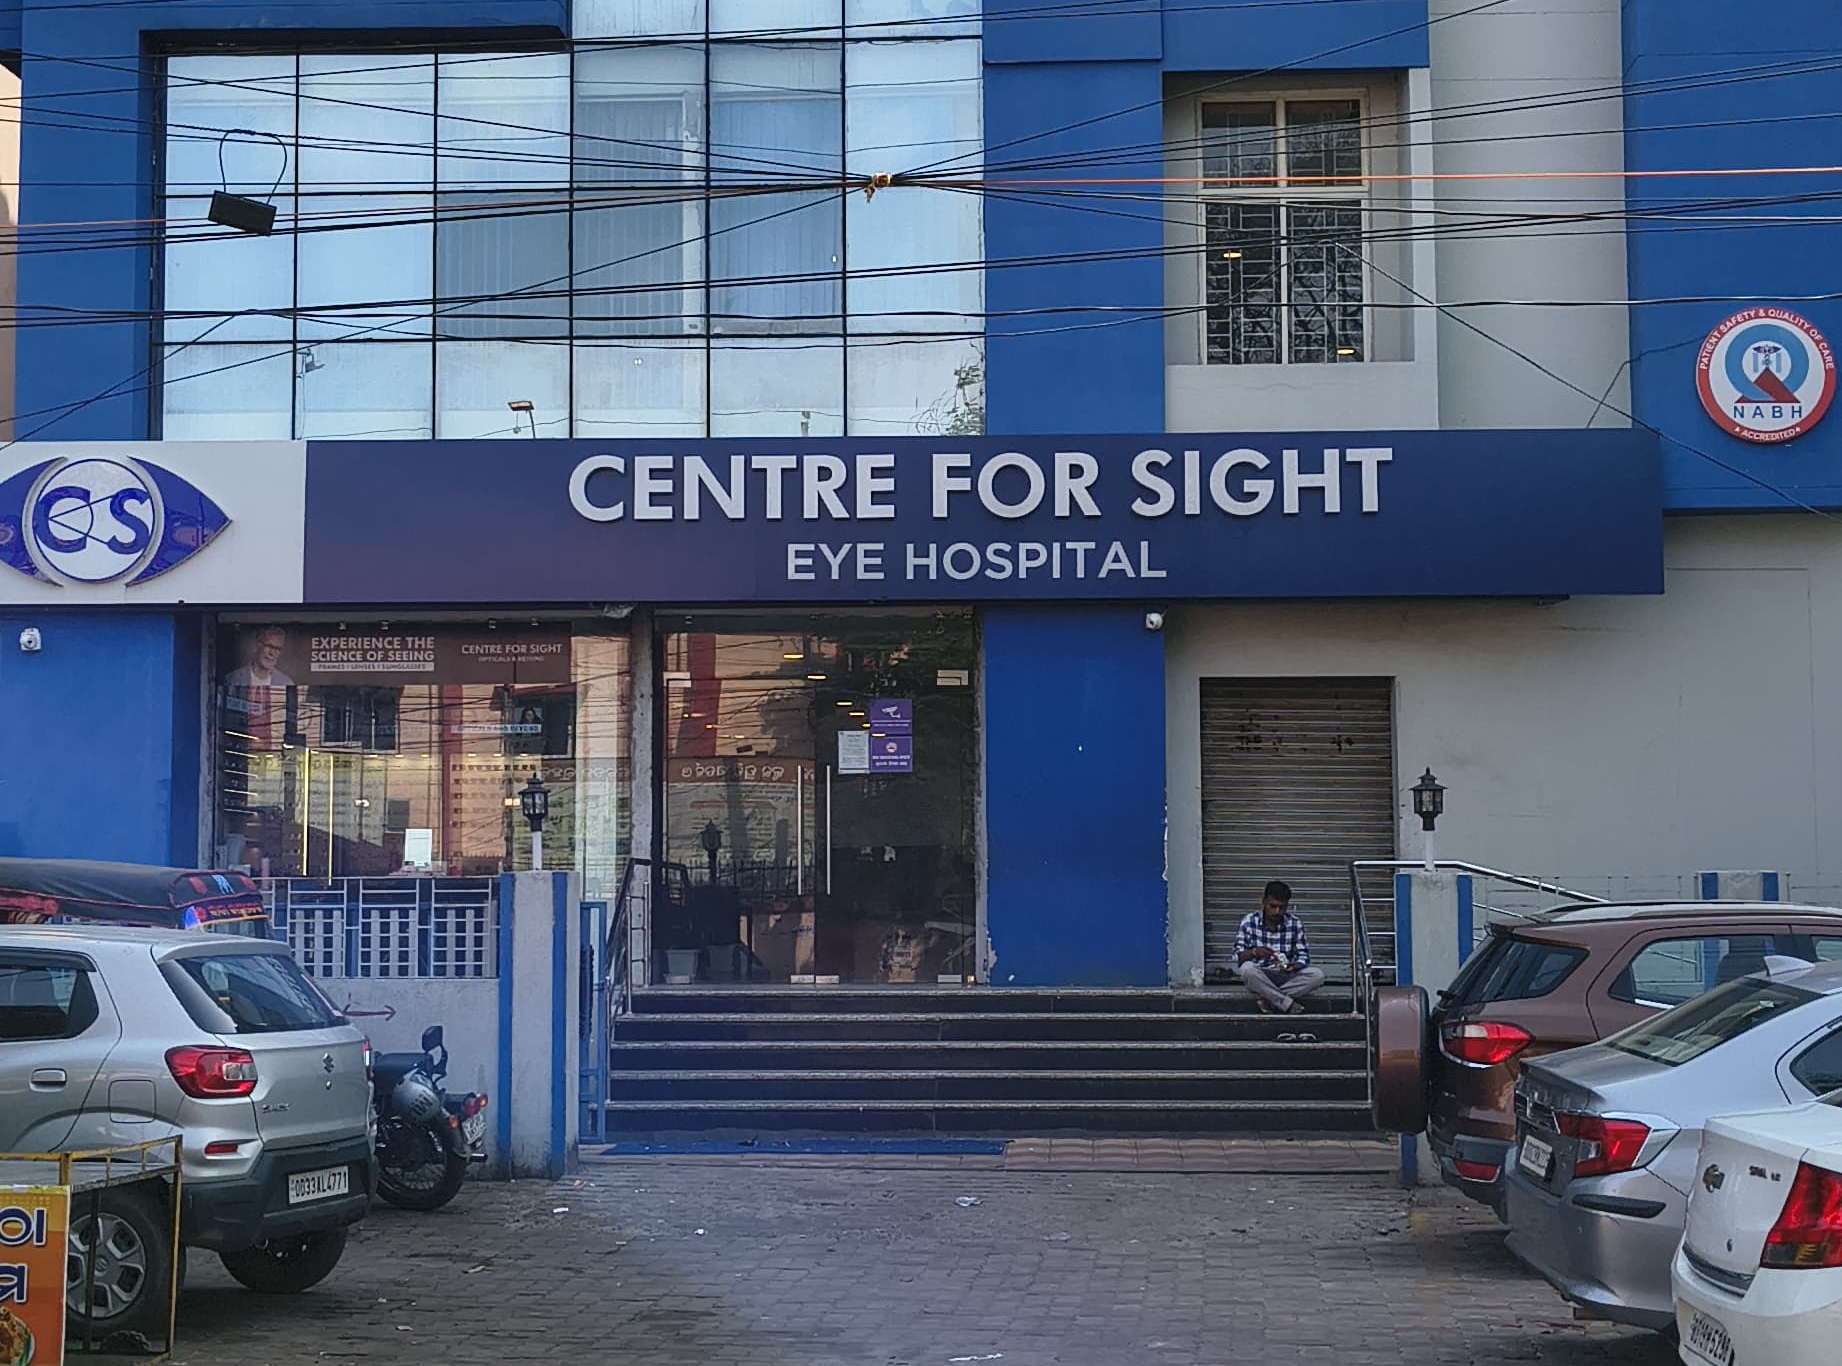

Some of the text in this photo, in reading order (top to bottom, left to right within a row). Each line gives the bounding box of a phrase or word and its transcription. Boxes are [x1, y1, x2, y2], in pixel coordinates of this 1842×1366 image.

[1700, 308, 1835, 370] PATIENT SAFETY & QUALITY OF CARE
[1733, 405, 1802, 419] NABH
[1742, 428, 1796, 441] ACCREDITED
[567, 447, 1395, 522] CENTRE FOR SIGHT
[787, 539, 1167, 581] EYE HOSPITAL
[311, 636, 435, 649] EXPERIENCE THE
[461, 643, 562, 654] CENTRE FOR SIGHT
[311, 650, 435, 662] SCIENCE OF SEEING
